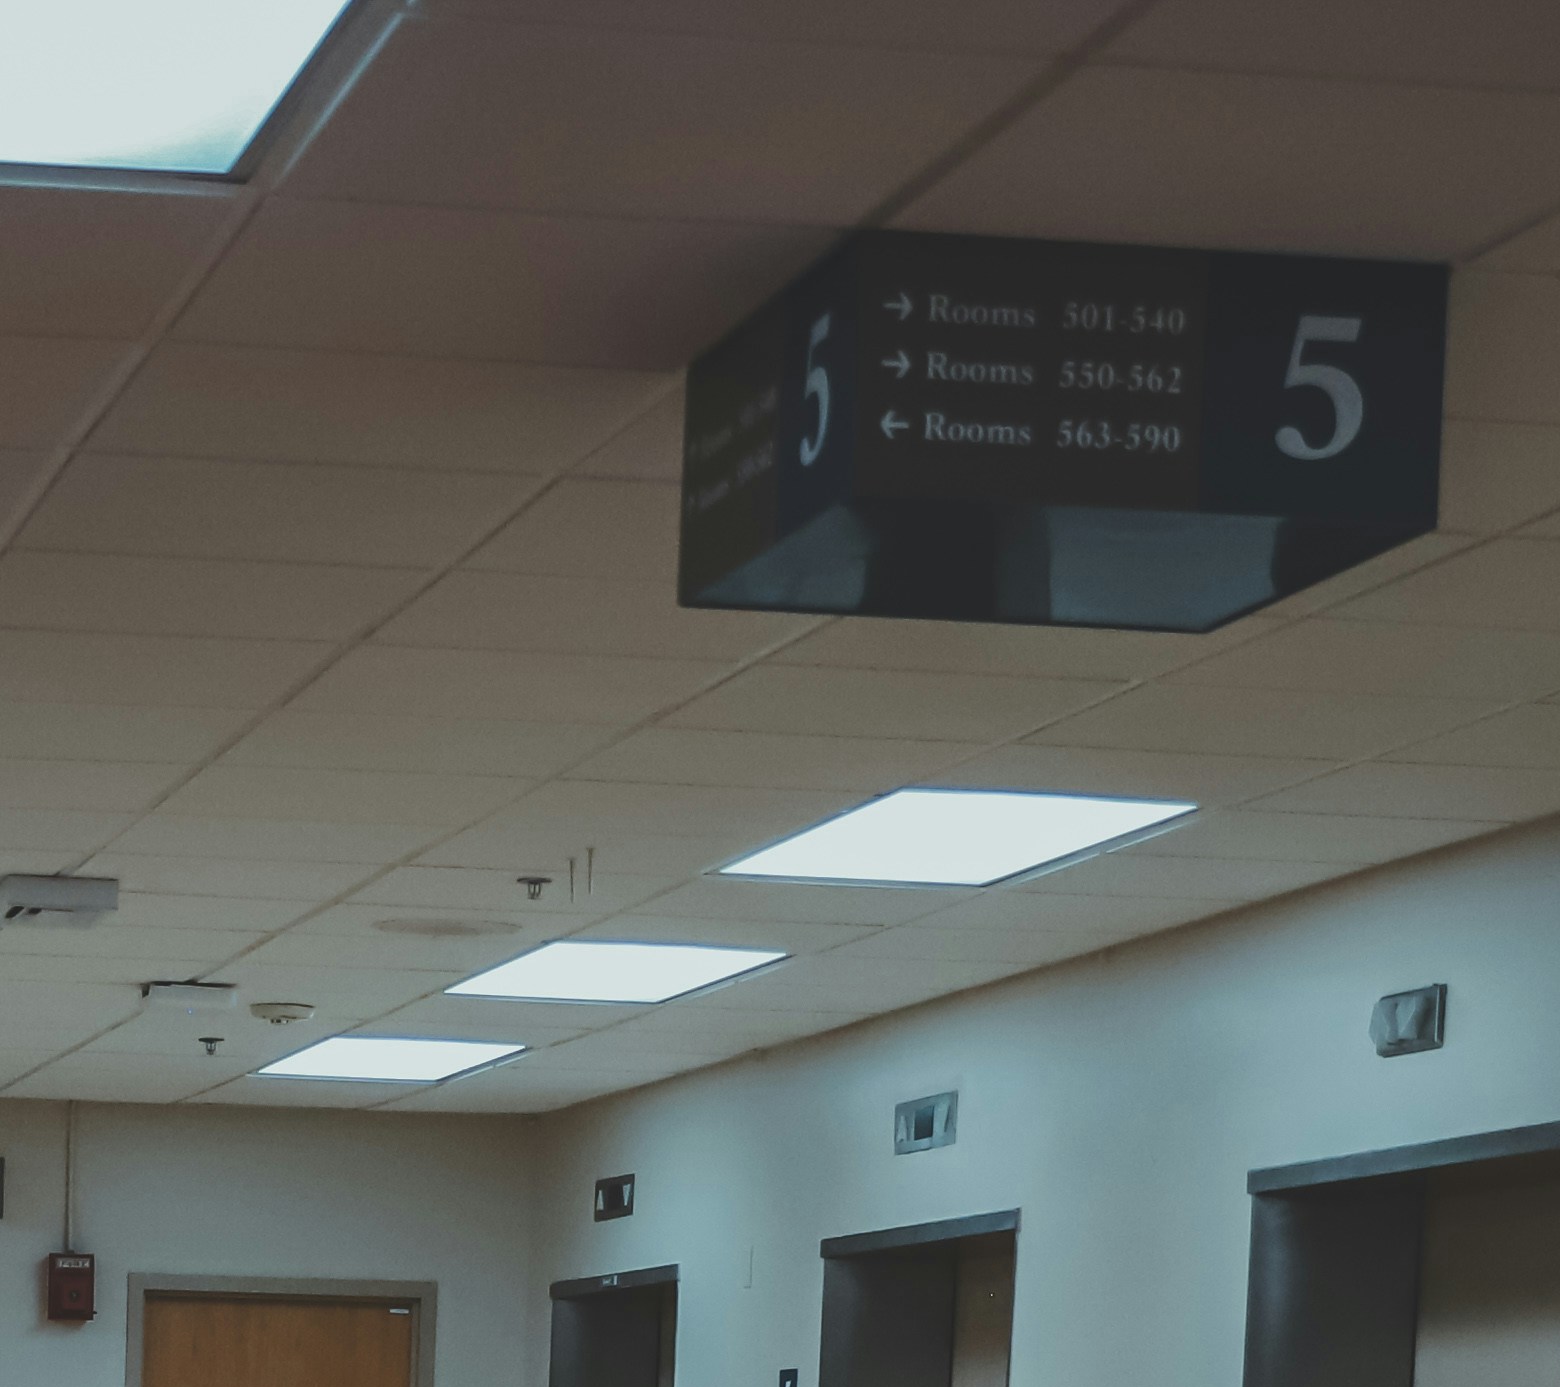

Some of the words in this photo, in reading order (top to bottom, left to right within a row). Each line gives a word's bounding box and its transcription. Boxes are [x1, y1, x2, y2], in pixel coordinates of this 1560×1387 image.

[929, 294, 1037, 328] Rooms
[1062, 301, 1186, 336] 501-540
[798, 312, 831, 467] 5
[926, 351, 1034, 386] Rooms
[1059, 360, 1182, 395] 550-562
[1274, 314, 1364, 461] 5
[924, 412, 1031, 447] Rooms
[1056, 420, 1182, 453] 563-590
